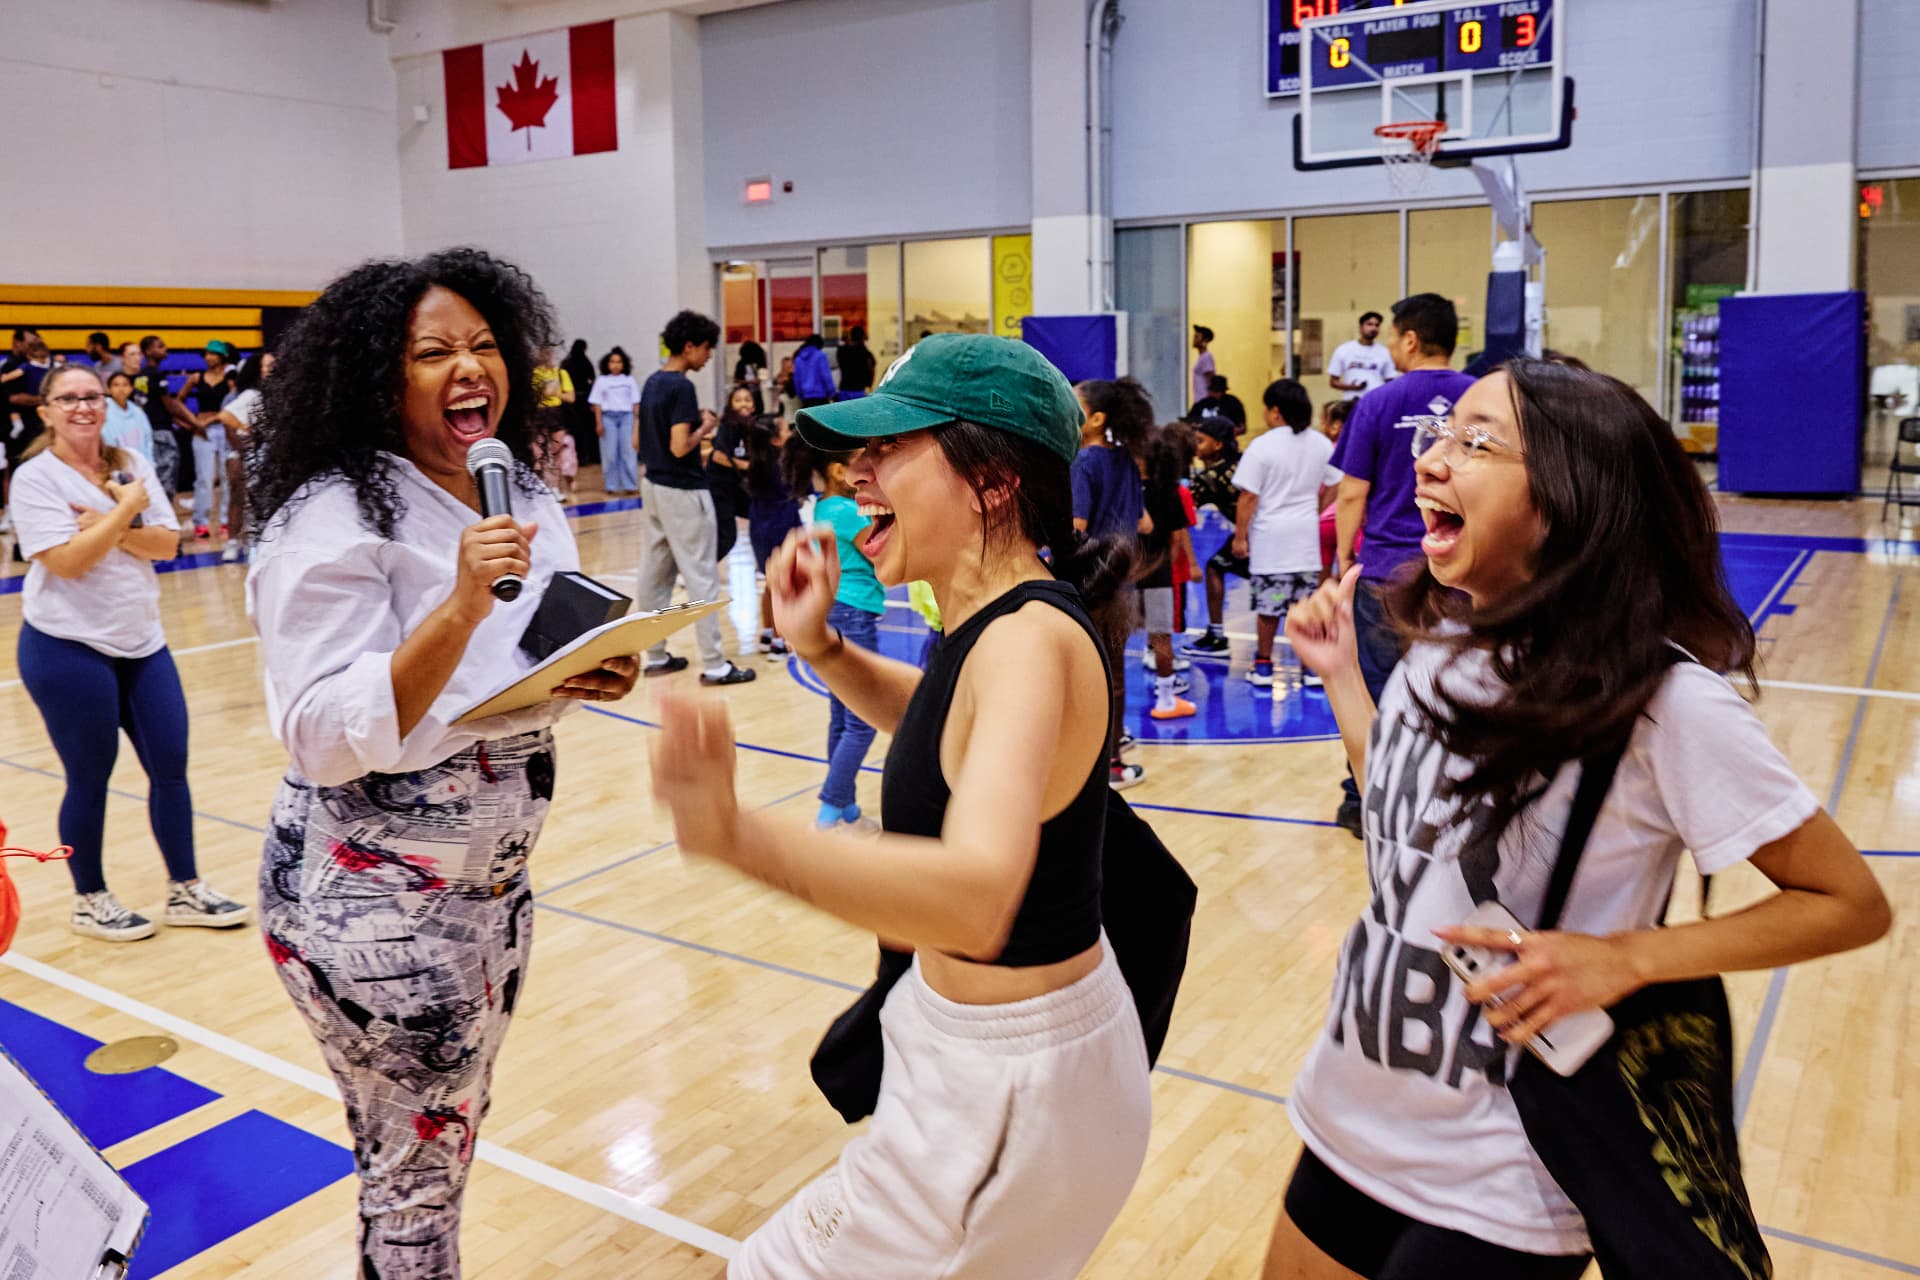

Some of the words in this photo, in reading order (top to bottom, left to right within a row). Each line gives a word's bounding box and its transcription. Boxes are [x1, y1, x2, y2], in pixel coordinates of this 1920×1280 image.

[1363, 18, 1408, 35] PLAYER
[1460, 20, 1482, 53] 0
[1515, 13, 1537, 47] 3
[1383, 63, 1425, 78] MATCH
